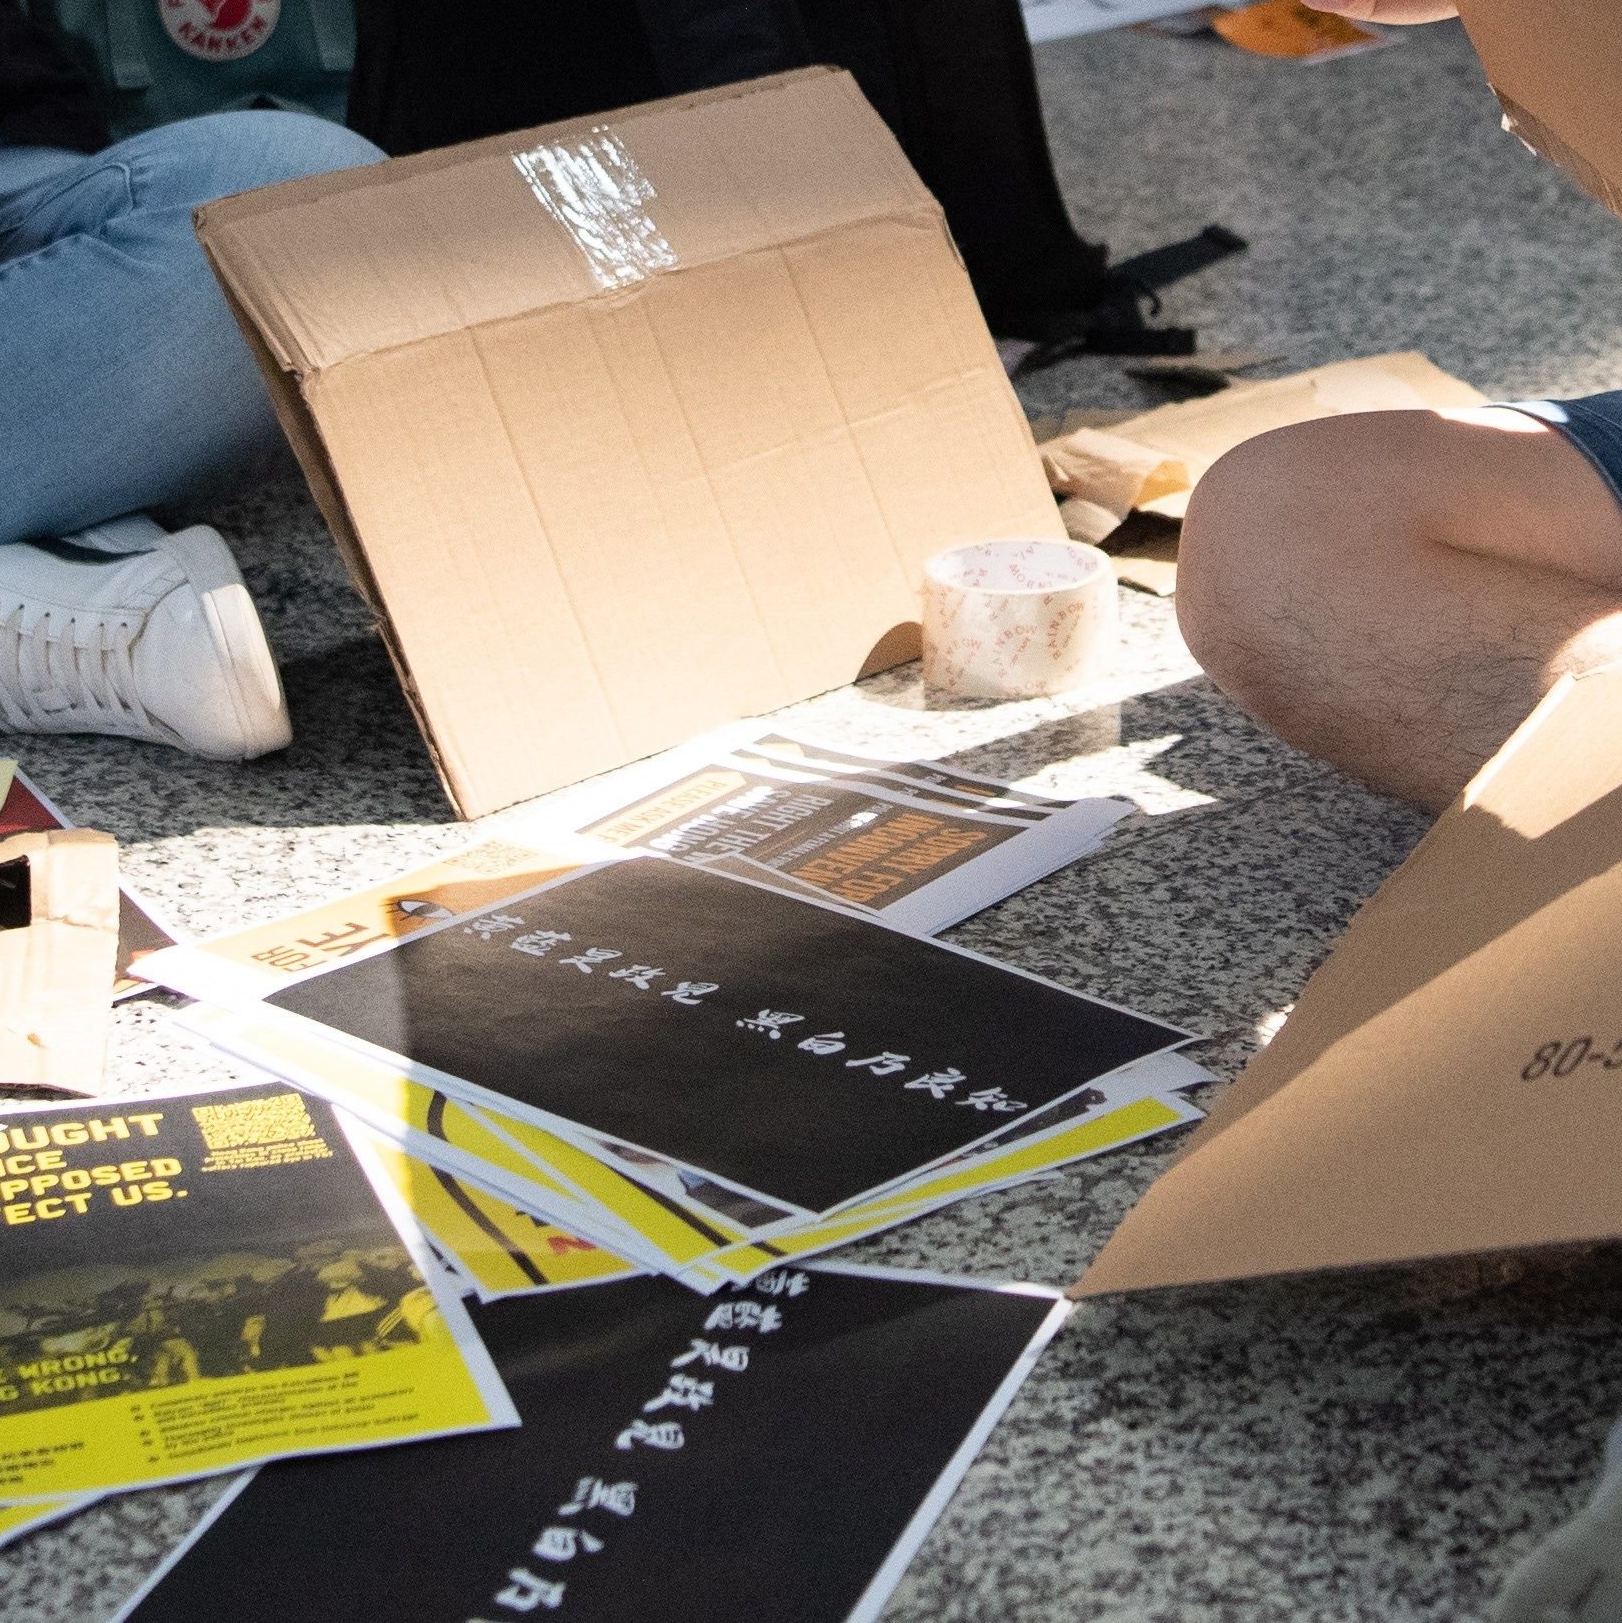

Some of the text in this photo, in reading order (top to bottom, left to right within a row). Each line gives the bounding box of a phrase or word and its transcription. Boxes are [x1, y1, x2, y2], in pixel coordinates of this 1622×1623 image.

[745, 793, 838, 831] RIGHT
[701, 826, 773, 855] THE
[874, 825, 990, 875] SORRY
[113, 1182, 187, 1207] US.
[18, 1348, 138, 1379] WRONG,
[32, 1367, 127, 1398] KONG.
